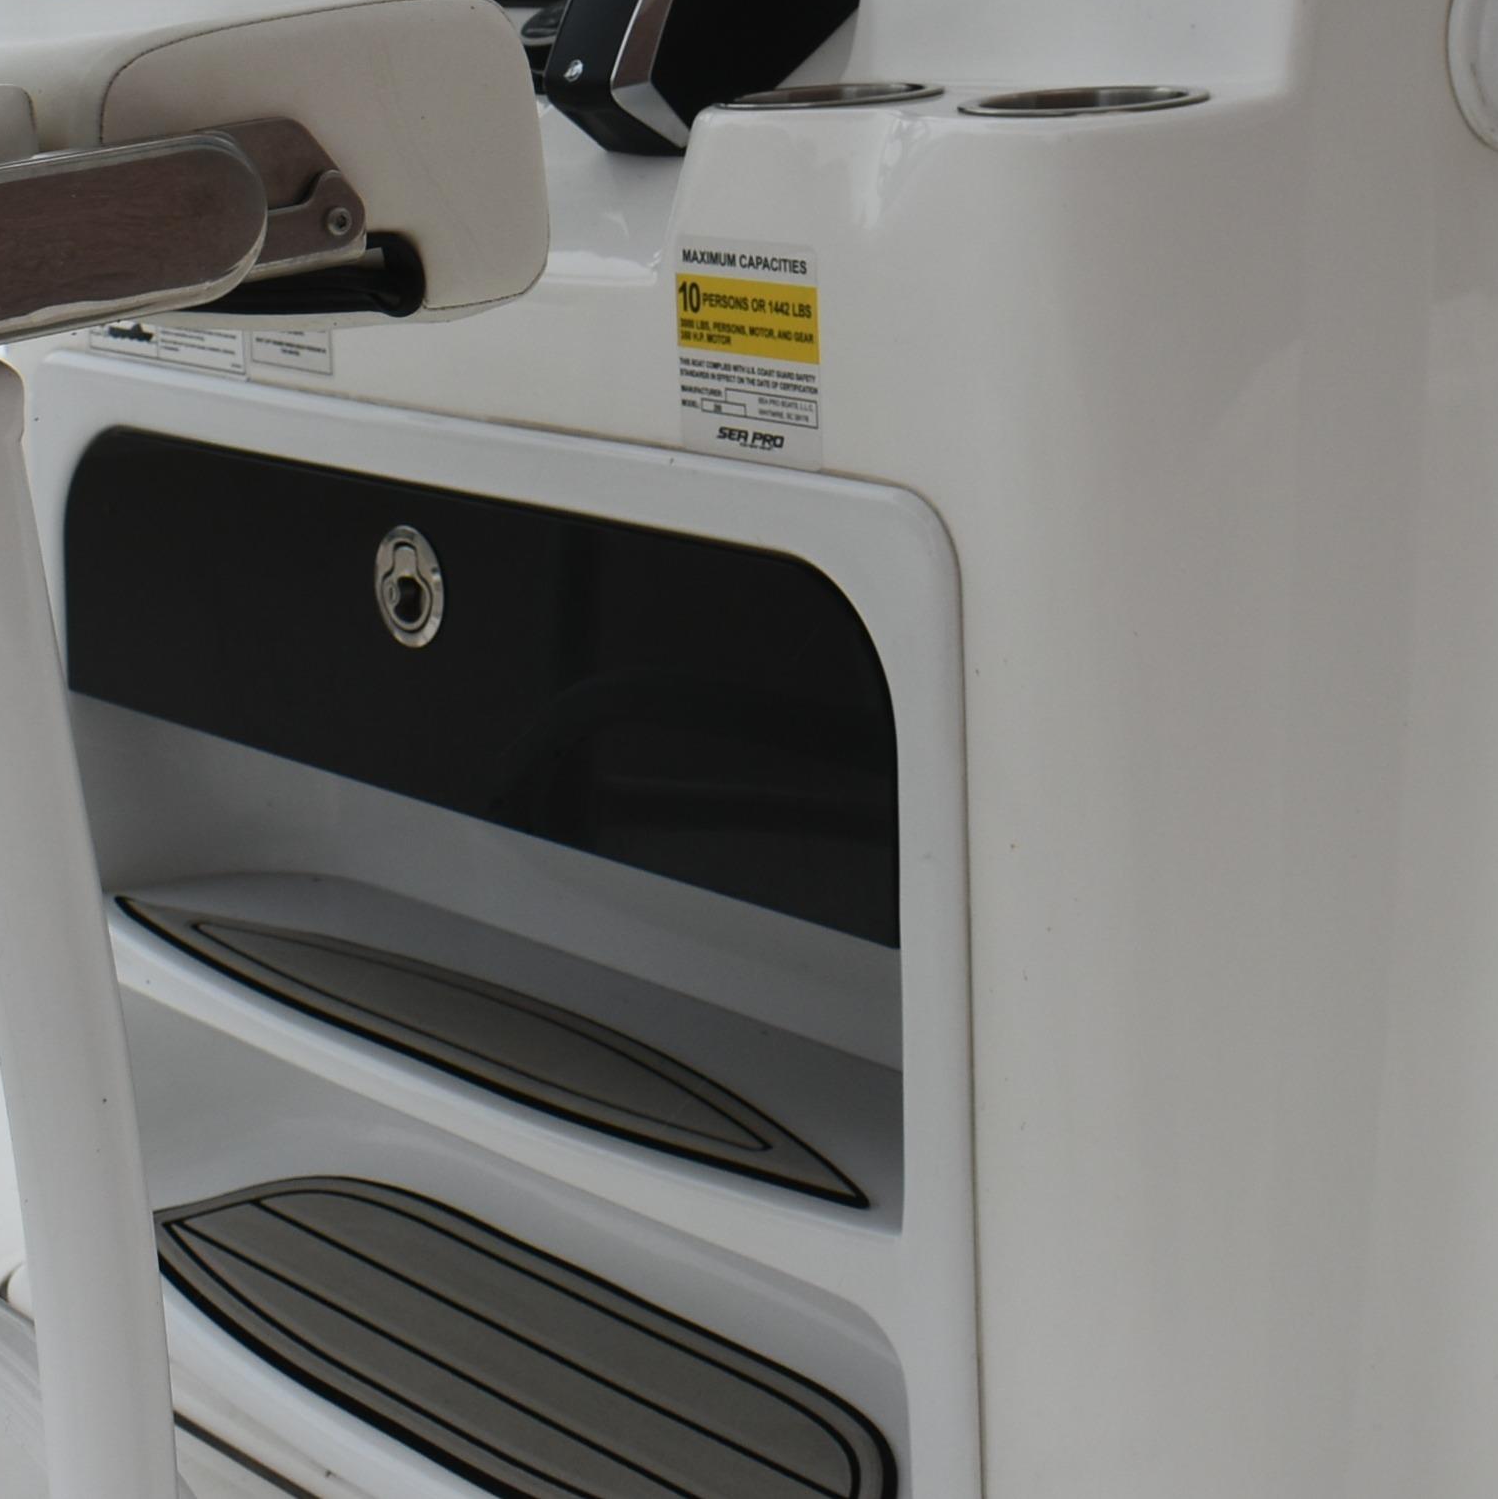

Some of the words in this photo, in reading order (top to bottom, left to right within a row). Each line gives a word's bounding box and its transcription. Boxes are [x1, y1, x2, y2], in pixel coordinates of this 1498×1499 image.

[682, 248, 736, 267] MAXIMUM
[739, 253, 808, 275] CAPACITIES
[678, 281, 701, 314] 10
[702, 292, 749, 312] PERSONS
[750, 297, 766, 313] OR
[768, 300, 790, 316] 1442
[792, 303, 812, 319] LBS
[706, 333, 732, 346] MOTOR
[778, 330, 793, 342] AND
[794, 331, 814, 344] GEAR
[716, 426, 749, 443] SEA
[751, 430, 785, 449] PRO
